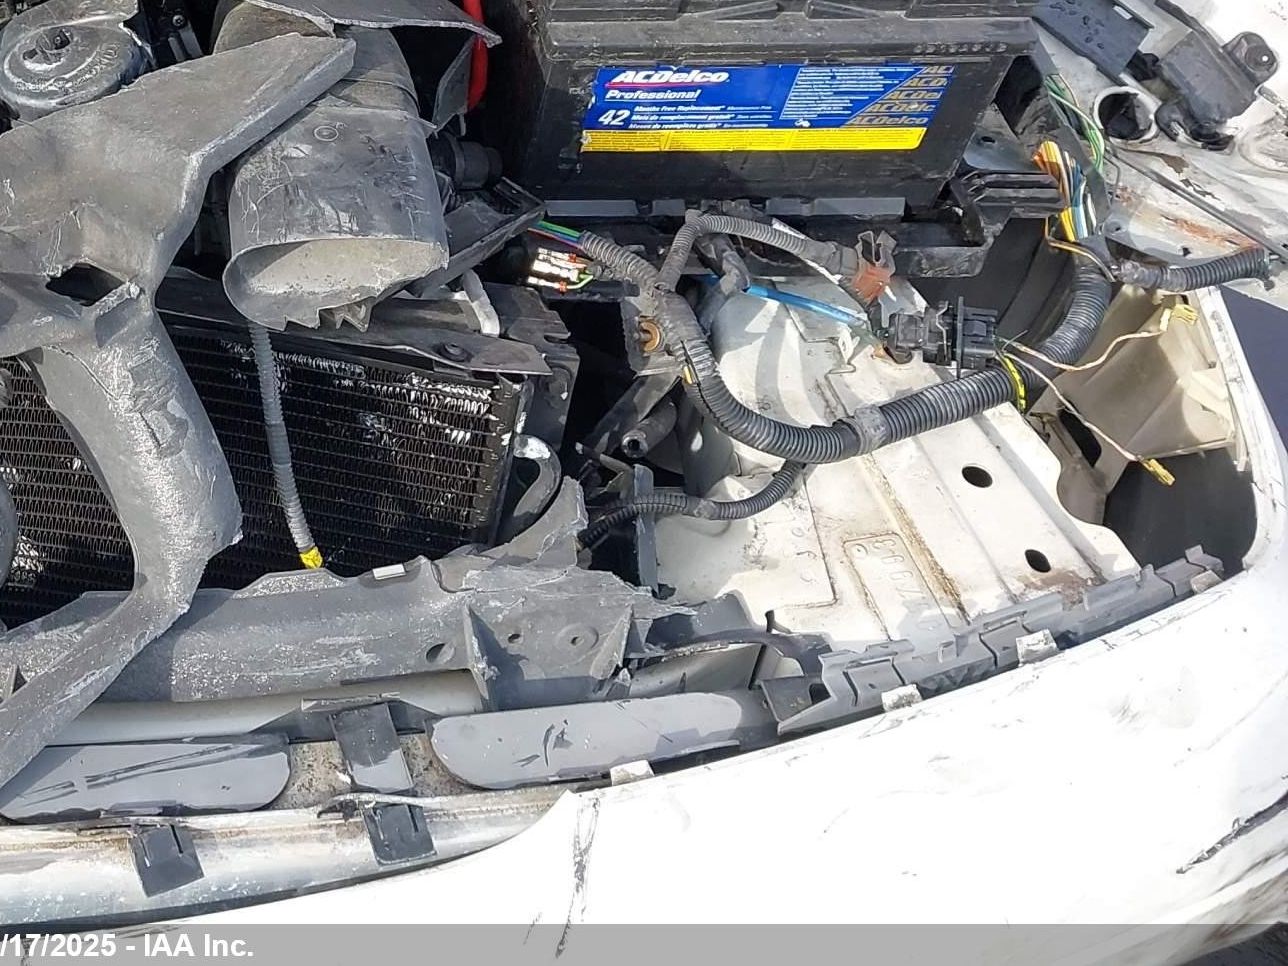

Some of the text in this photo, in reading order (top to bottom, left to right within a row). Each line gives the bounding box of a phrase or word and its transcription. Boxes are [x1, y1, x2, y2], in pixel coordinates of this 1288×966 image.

[610, 69, 729, 83] ACDelco
[604, 89, 701, 100] Professional
[598, 109, 631, 125] 42
[848, 115, 929, 126] ACDelco
